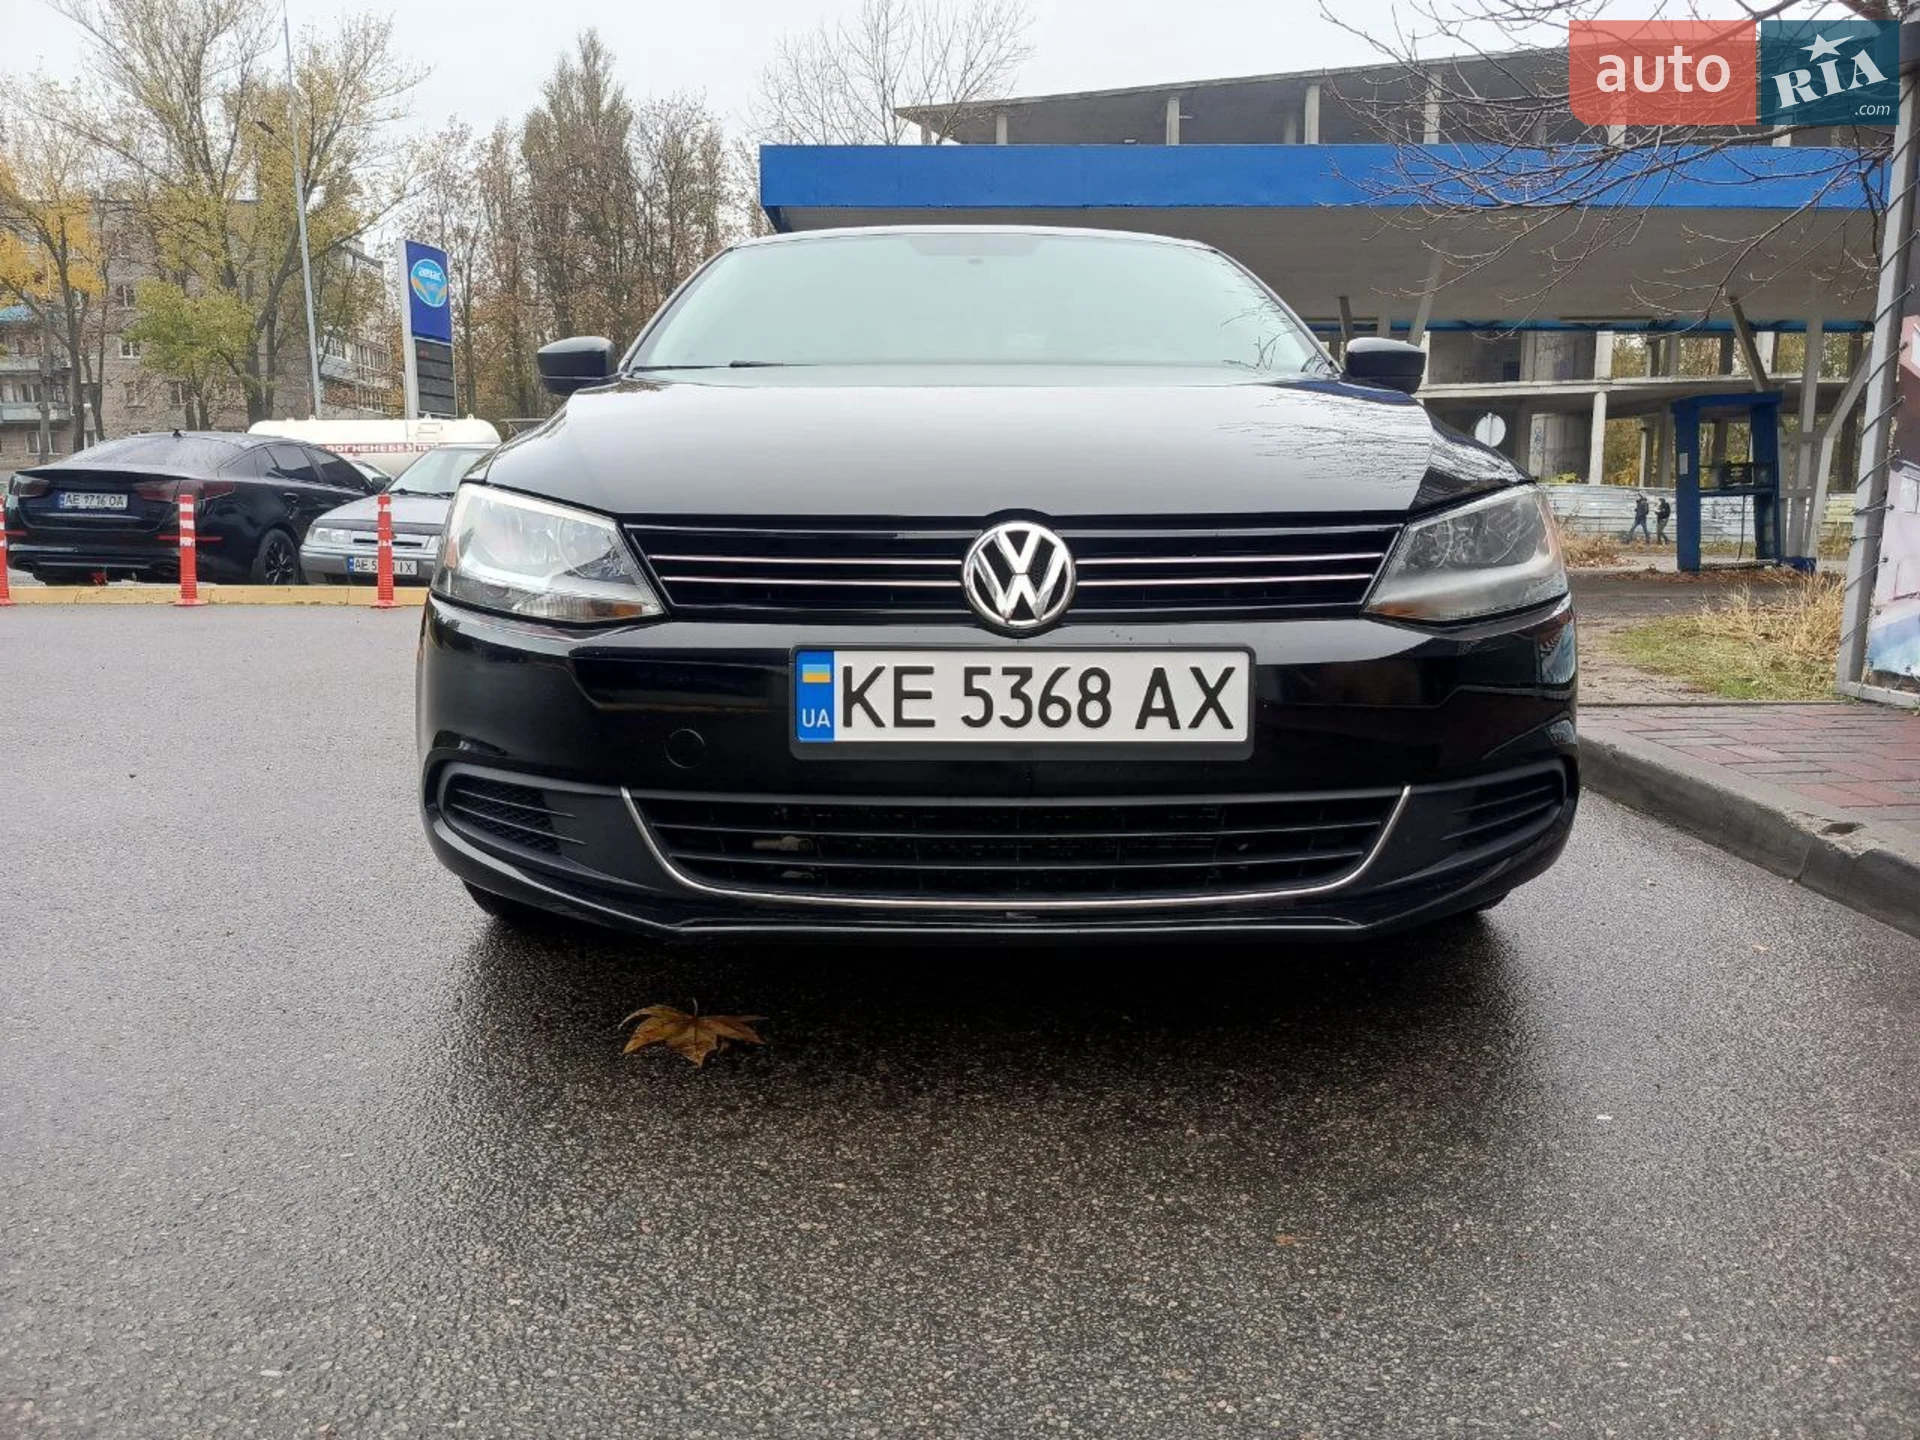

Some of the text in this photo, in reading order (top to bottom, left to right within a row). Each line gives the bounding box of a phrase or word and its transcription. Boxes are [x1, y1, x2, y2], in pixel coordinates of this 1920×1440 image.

[355, 559, 370, 571] AE
[842, 665, 1236, 730] KE 5368 AX
[802, 708, 831, 728] UA
